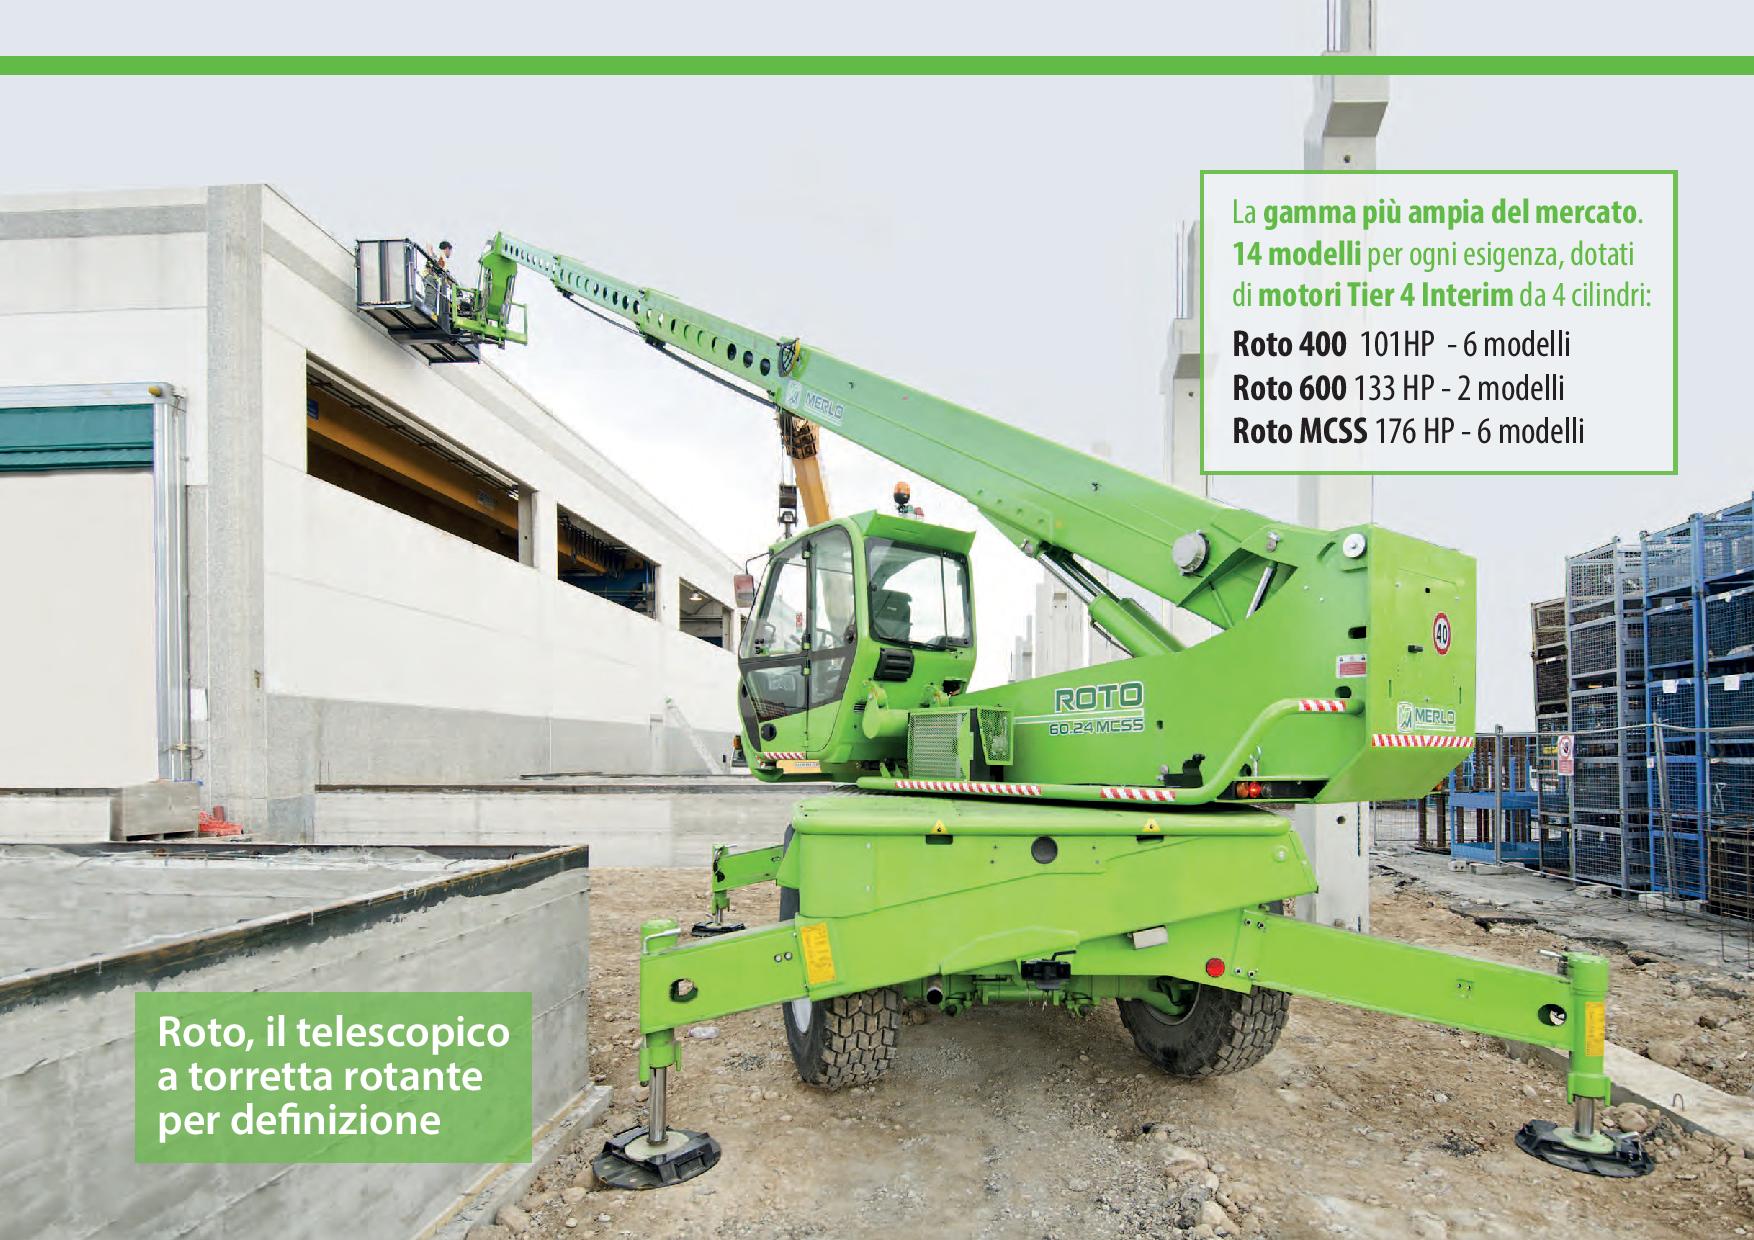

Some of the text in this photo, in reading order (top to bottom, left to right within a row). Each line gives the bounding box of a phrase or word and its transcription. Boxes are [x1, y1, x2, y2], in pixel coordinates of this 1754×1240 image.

[805, 391, 844, 419] MERLO
[1436, 624, 1448, 644] 40
[1055, 681, 1144, 713] ROTO
[1415, 707, 1456, 725] MERLO
[1049, 718, 1144, 736] 60.24 MCSS
